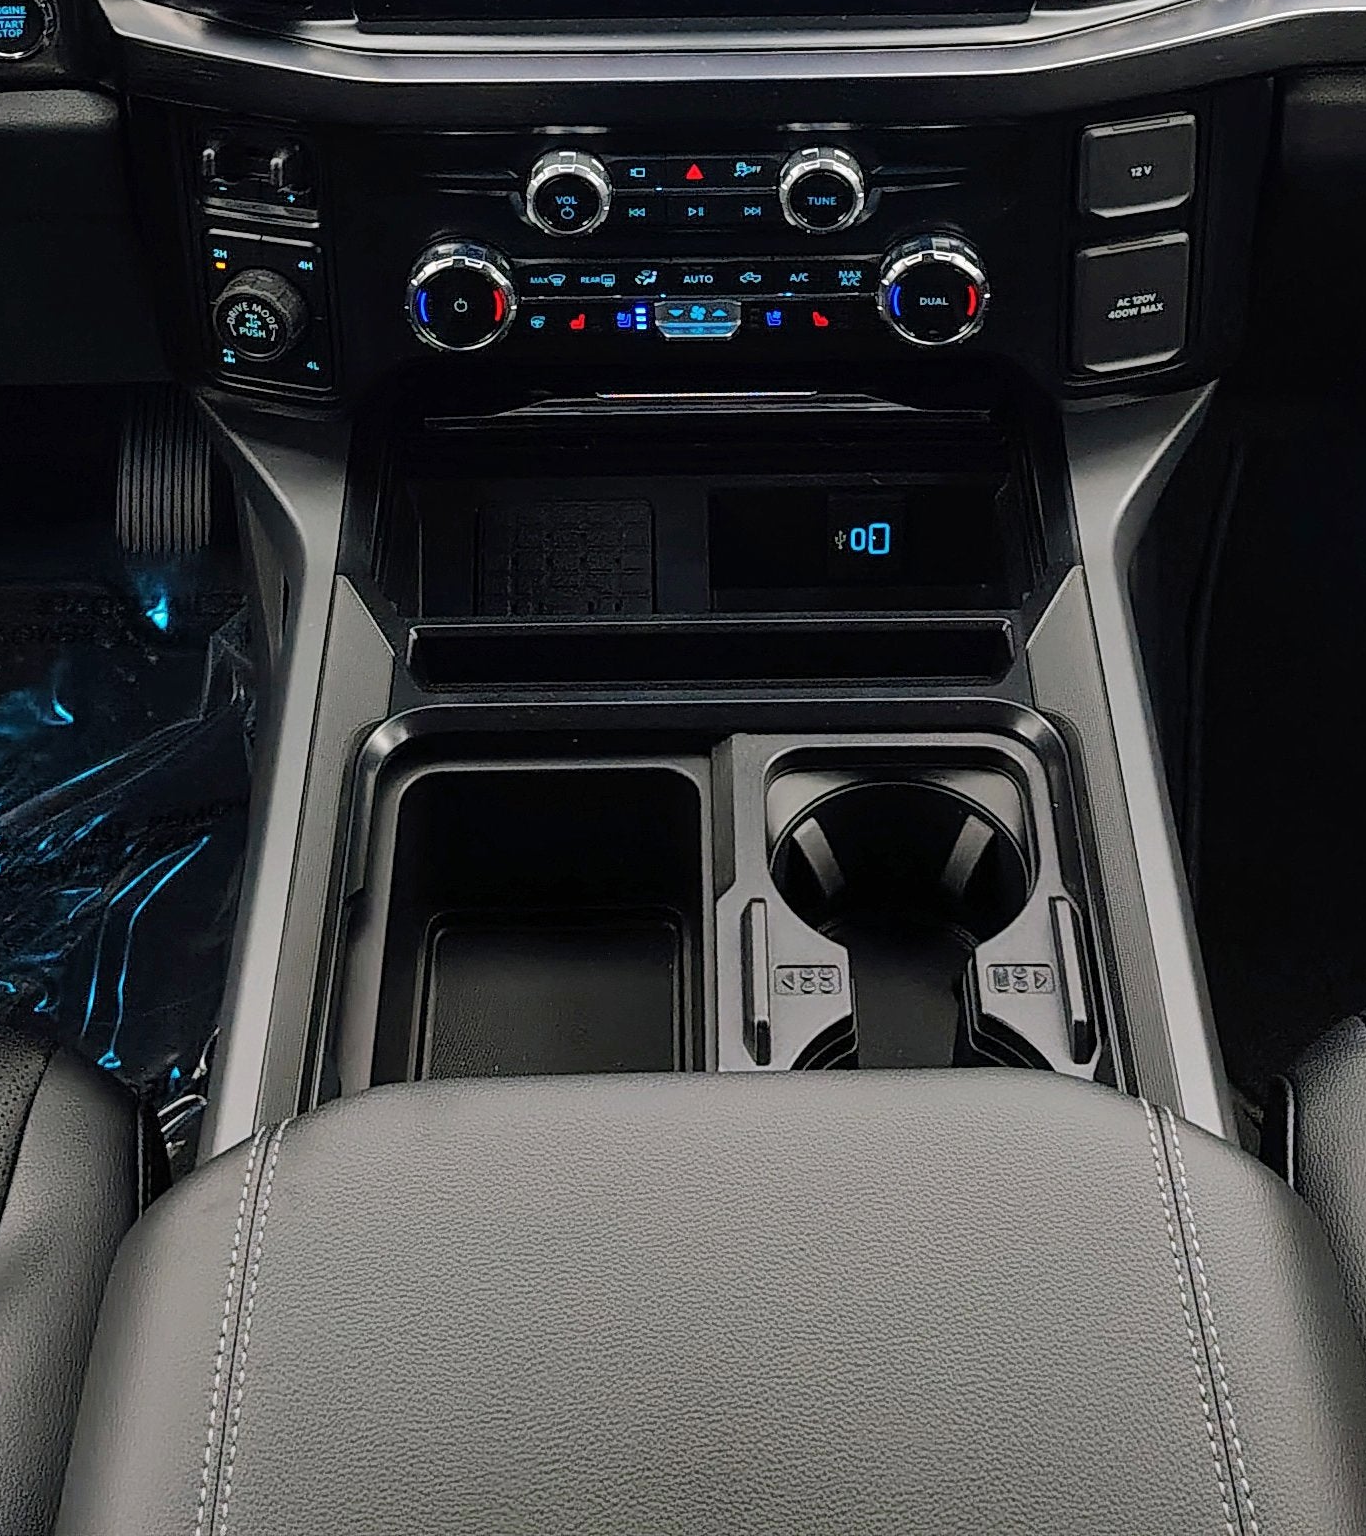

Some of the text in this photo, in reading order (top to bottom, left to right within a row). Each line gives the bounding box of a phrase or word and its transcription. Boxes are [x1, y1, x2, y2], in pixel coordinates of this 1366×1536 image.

[556, 196, 578, 205] VOL
[807, 196, 838, 206] TUNE
[212, 249, 227, 259] 2H
[298, 261, 313, 271] 4H
[683, 275, 714, 284] AUTO
[789, 272, 809, 283] A/C
[838, 270, 862, 279] MAX
[529, 276, 549, 284] MAX
[580, 276, 600, 284] REAR
[840, 277, 861, 287] A/C
[919, 296, 949, 306] DUAL
[1117, 293, 1156, 308] AC 120V
[1108, 302, 1164, 318] 400W MAX
[227, 302, 279, 330] DRIVE MODE
[239, 326, 266, 338] PUSH
[306, 361, 320, 371] 4L
